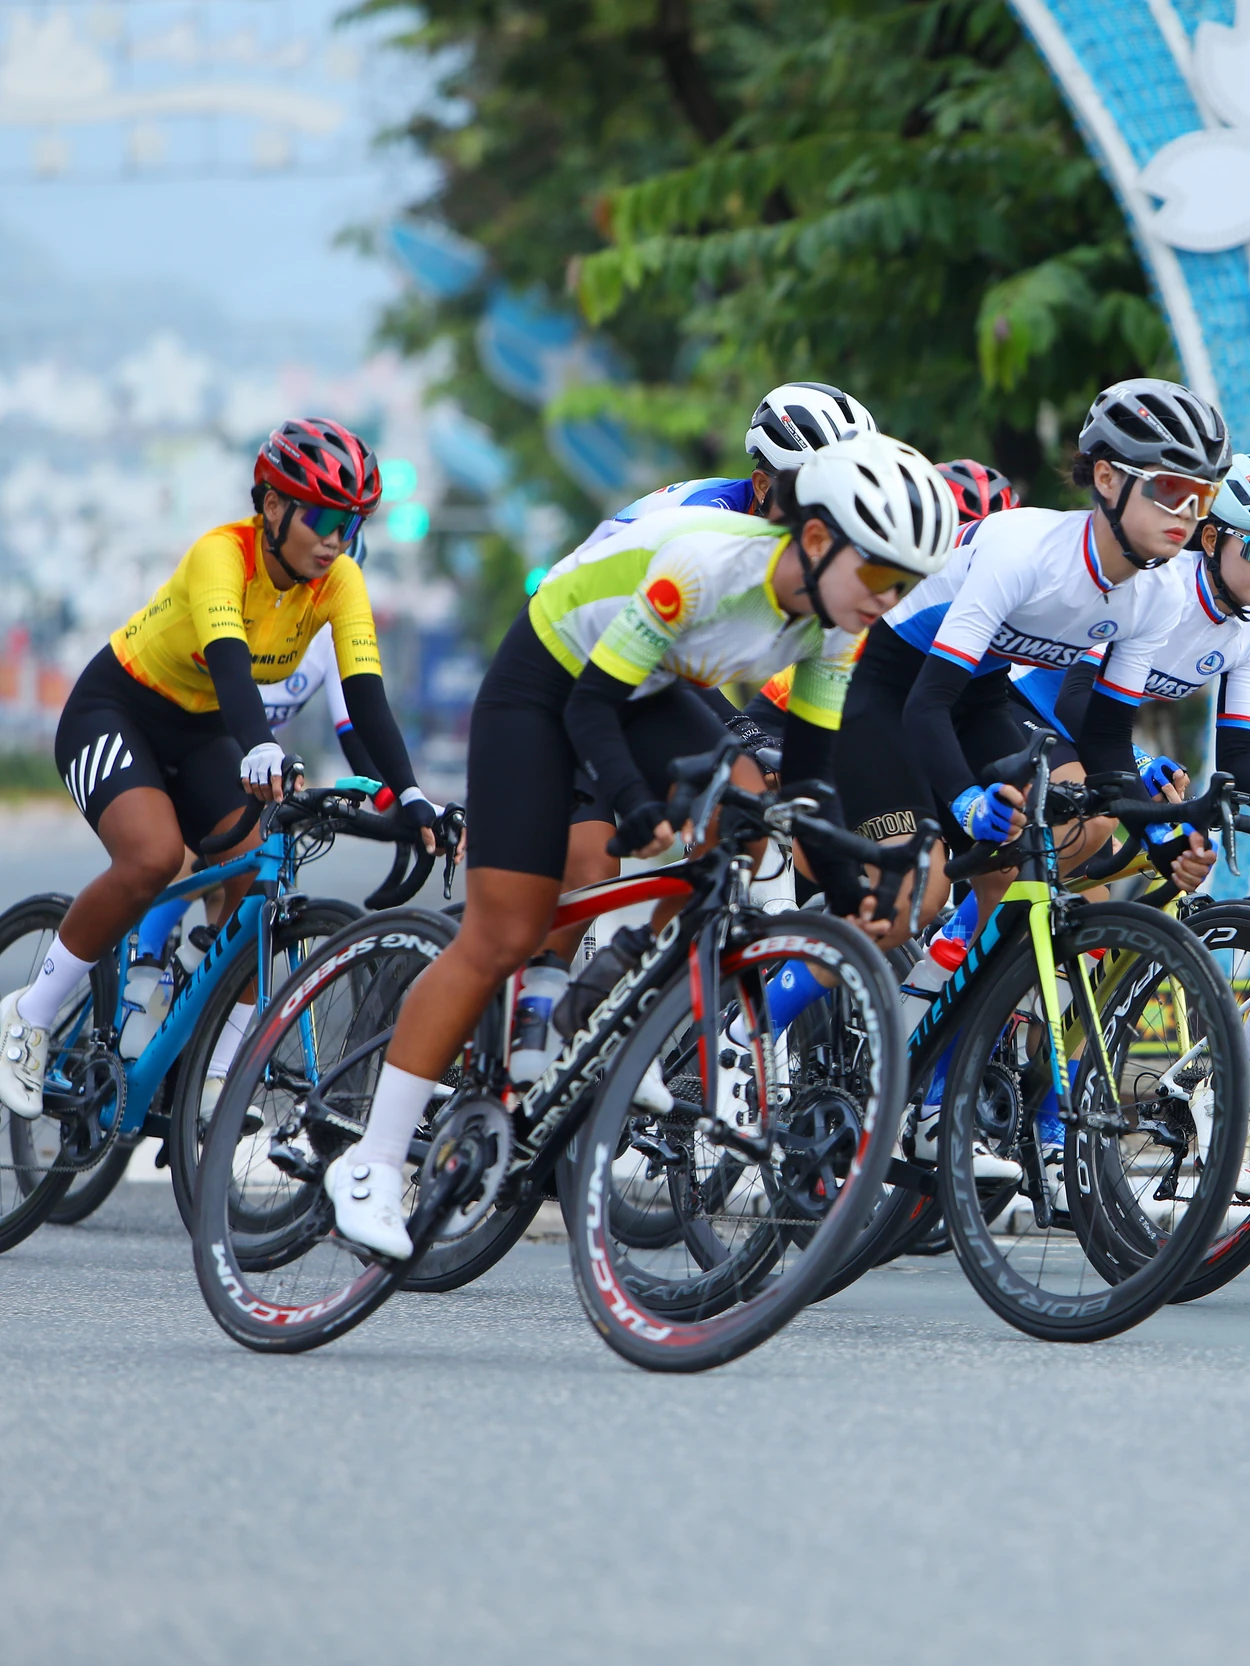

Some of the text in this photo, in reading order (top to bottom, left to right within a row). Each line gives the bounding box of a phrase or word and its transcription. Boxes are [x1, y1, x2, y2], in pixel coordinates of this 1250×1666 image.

[1145, 672, 1200, 700] WASE
[853, 810, 918, 841] NTON
[743, 935, 843, 967] SPEED
[523, 914, 681, 1118] PINARELLO
[586, 1141, 674, 1342] FULCRUM
